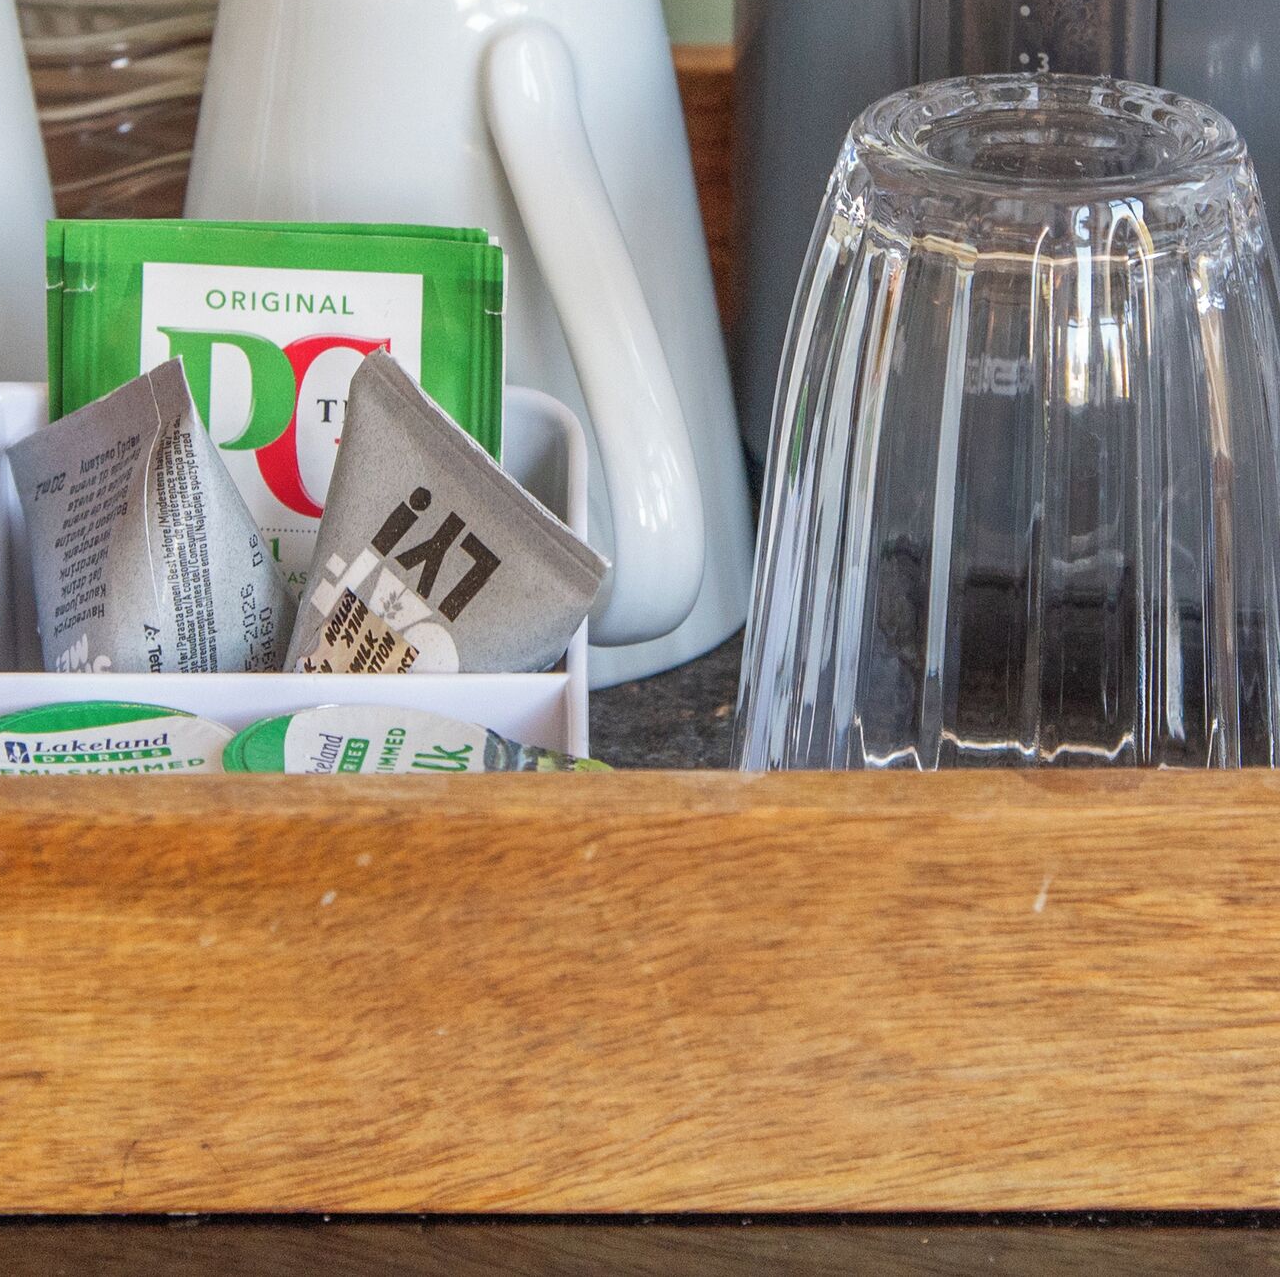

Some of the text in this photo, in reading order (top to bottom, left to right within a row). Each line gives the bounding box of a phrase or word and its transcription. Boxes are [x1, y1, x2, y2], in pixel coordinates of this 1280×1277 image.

[1037, 52, 1050, 73] 3
[206, 289, 355, 315] ORIGINAL
[324, 590, 357, 647] RATION
[340, 598, 369, 649] MILK
[34, 733, 170, 752] Lakeland
[41, 748, 164, 764] DAIRIES
